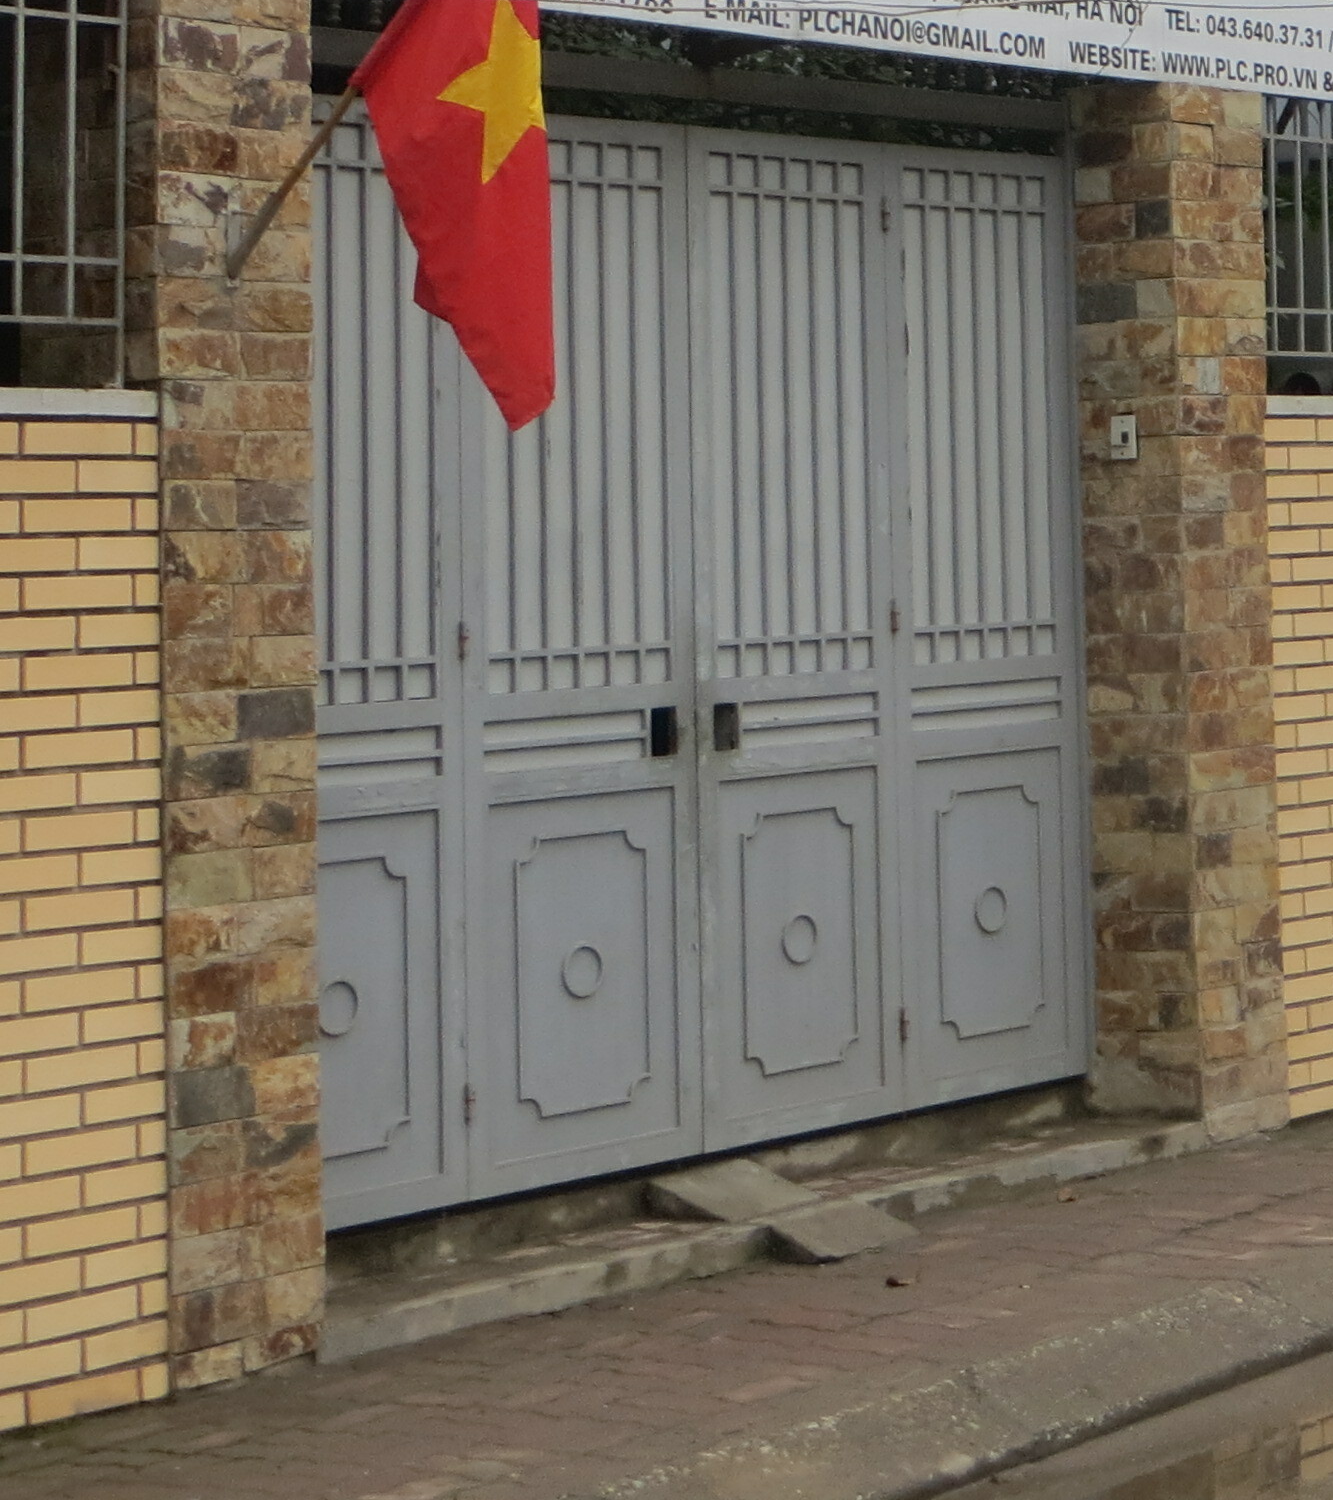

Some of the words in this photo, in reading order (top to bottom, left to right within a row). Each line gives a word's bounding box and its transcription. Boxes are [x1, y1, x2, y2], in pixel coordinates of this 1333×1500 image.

[799, 8, 1046, 59] PLCHANOI@GMAIL.COM
[1069, 40, 1156, 73] WEBSITE:
[1161, 51, 1318, 90] WWW.PLC.PRO.VN
[1165, 8, 1200, 34] TEL:
[1206, 14, 1324, 50] 043.640.37.31
